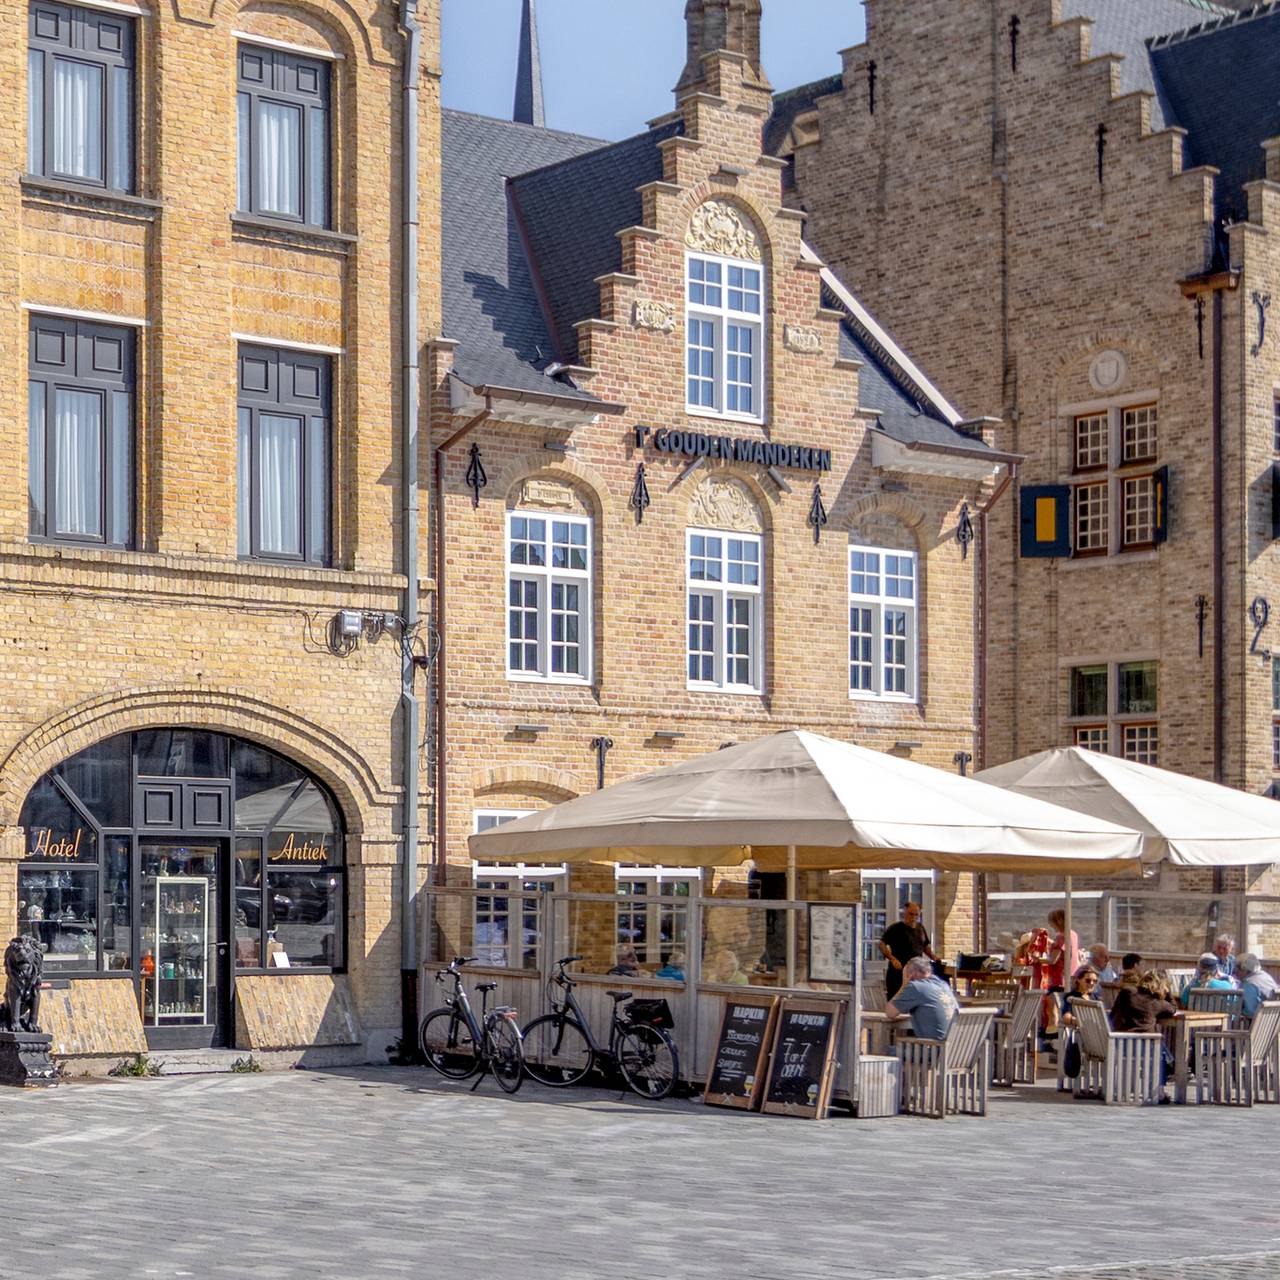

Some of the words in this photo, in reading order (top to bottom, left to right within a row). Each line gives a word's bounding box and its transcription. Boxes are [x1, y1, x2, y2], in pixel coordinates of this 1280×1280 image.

[655, 428, 734, 460] GOUDEN
[735, 439, 831, 470] MANDEKEN
[27, 828, 81, 857] Hotel
[271, 832, 328, 860] Antiek
